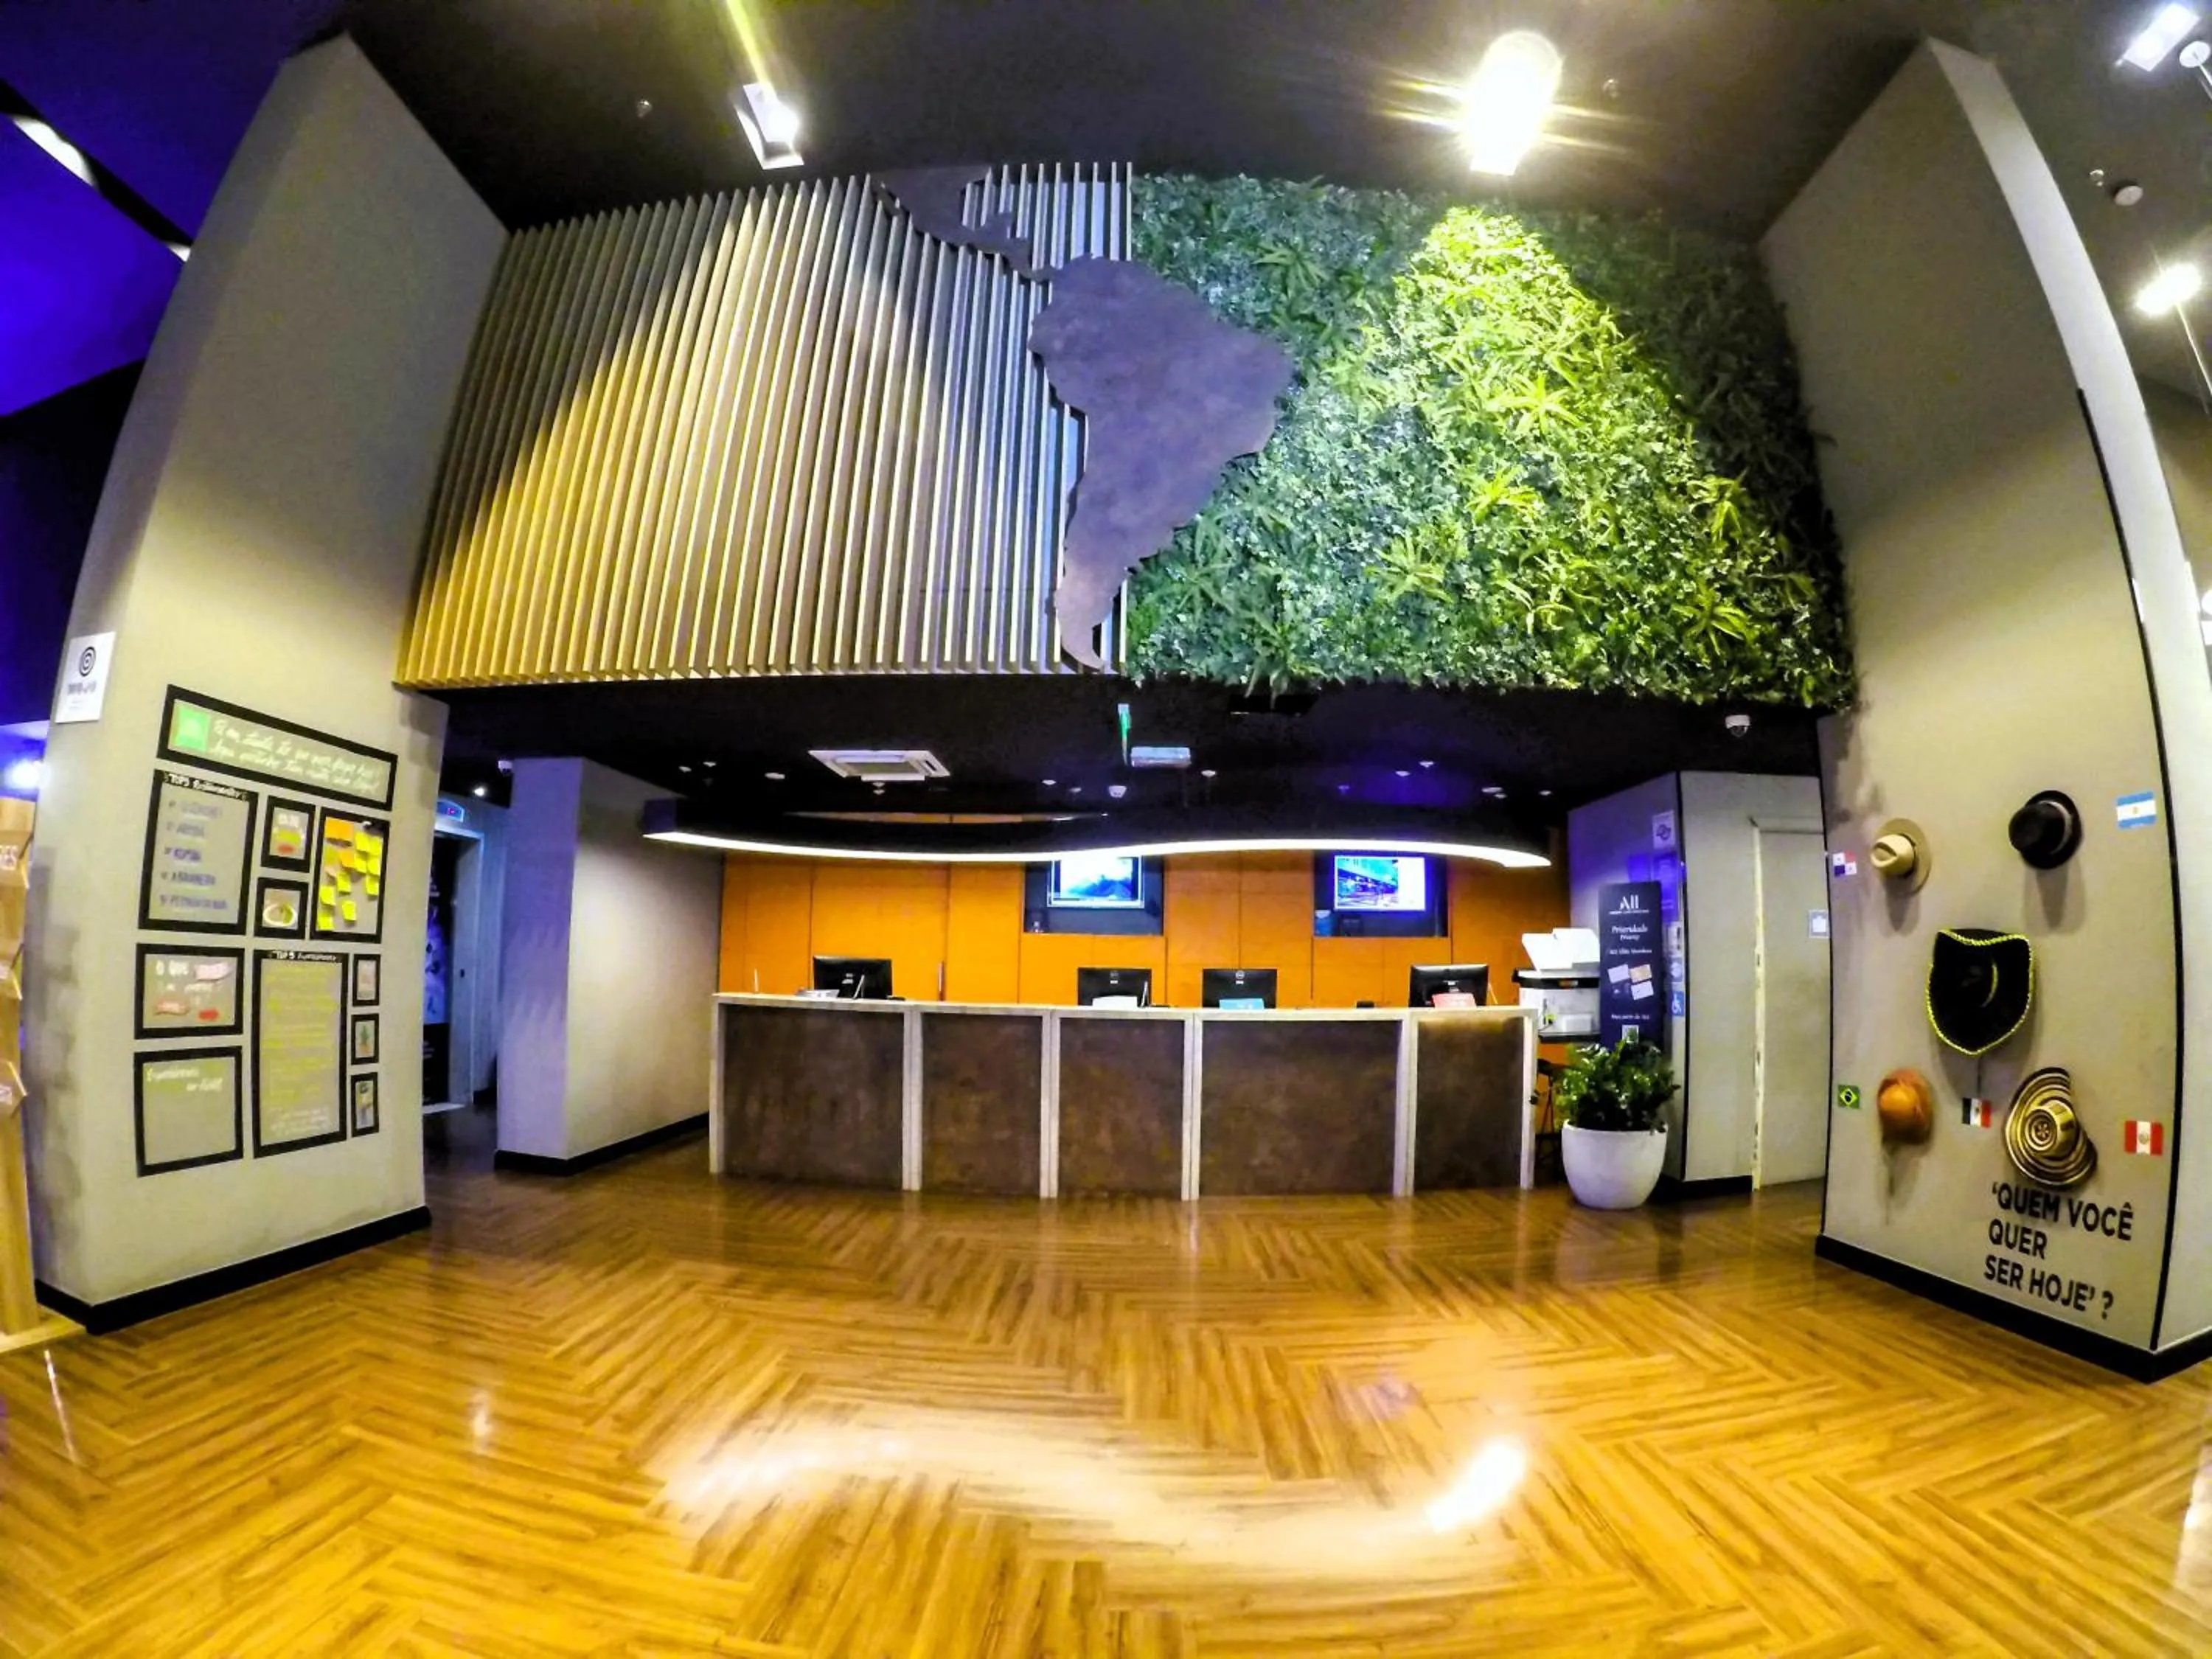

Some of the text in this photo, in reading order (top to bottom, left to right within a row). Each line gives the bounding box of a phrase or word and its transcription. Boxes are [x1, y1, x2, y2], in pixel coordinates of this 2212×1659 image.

[1989, 1218, 2048, 1259] QUER
[1992, 1182, 2134, 1241] 'QUEM VOCÊ
[1983, 1254, 2114, 1320] SER HOJE' ?
